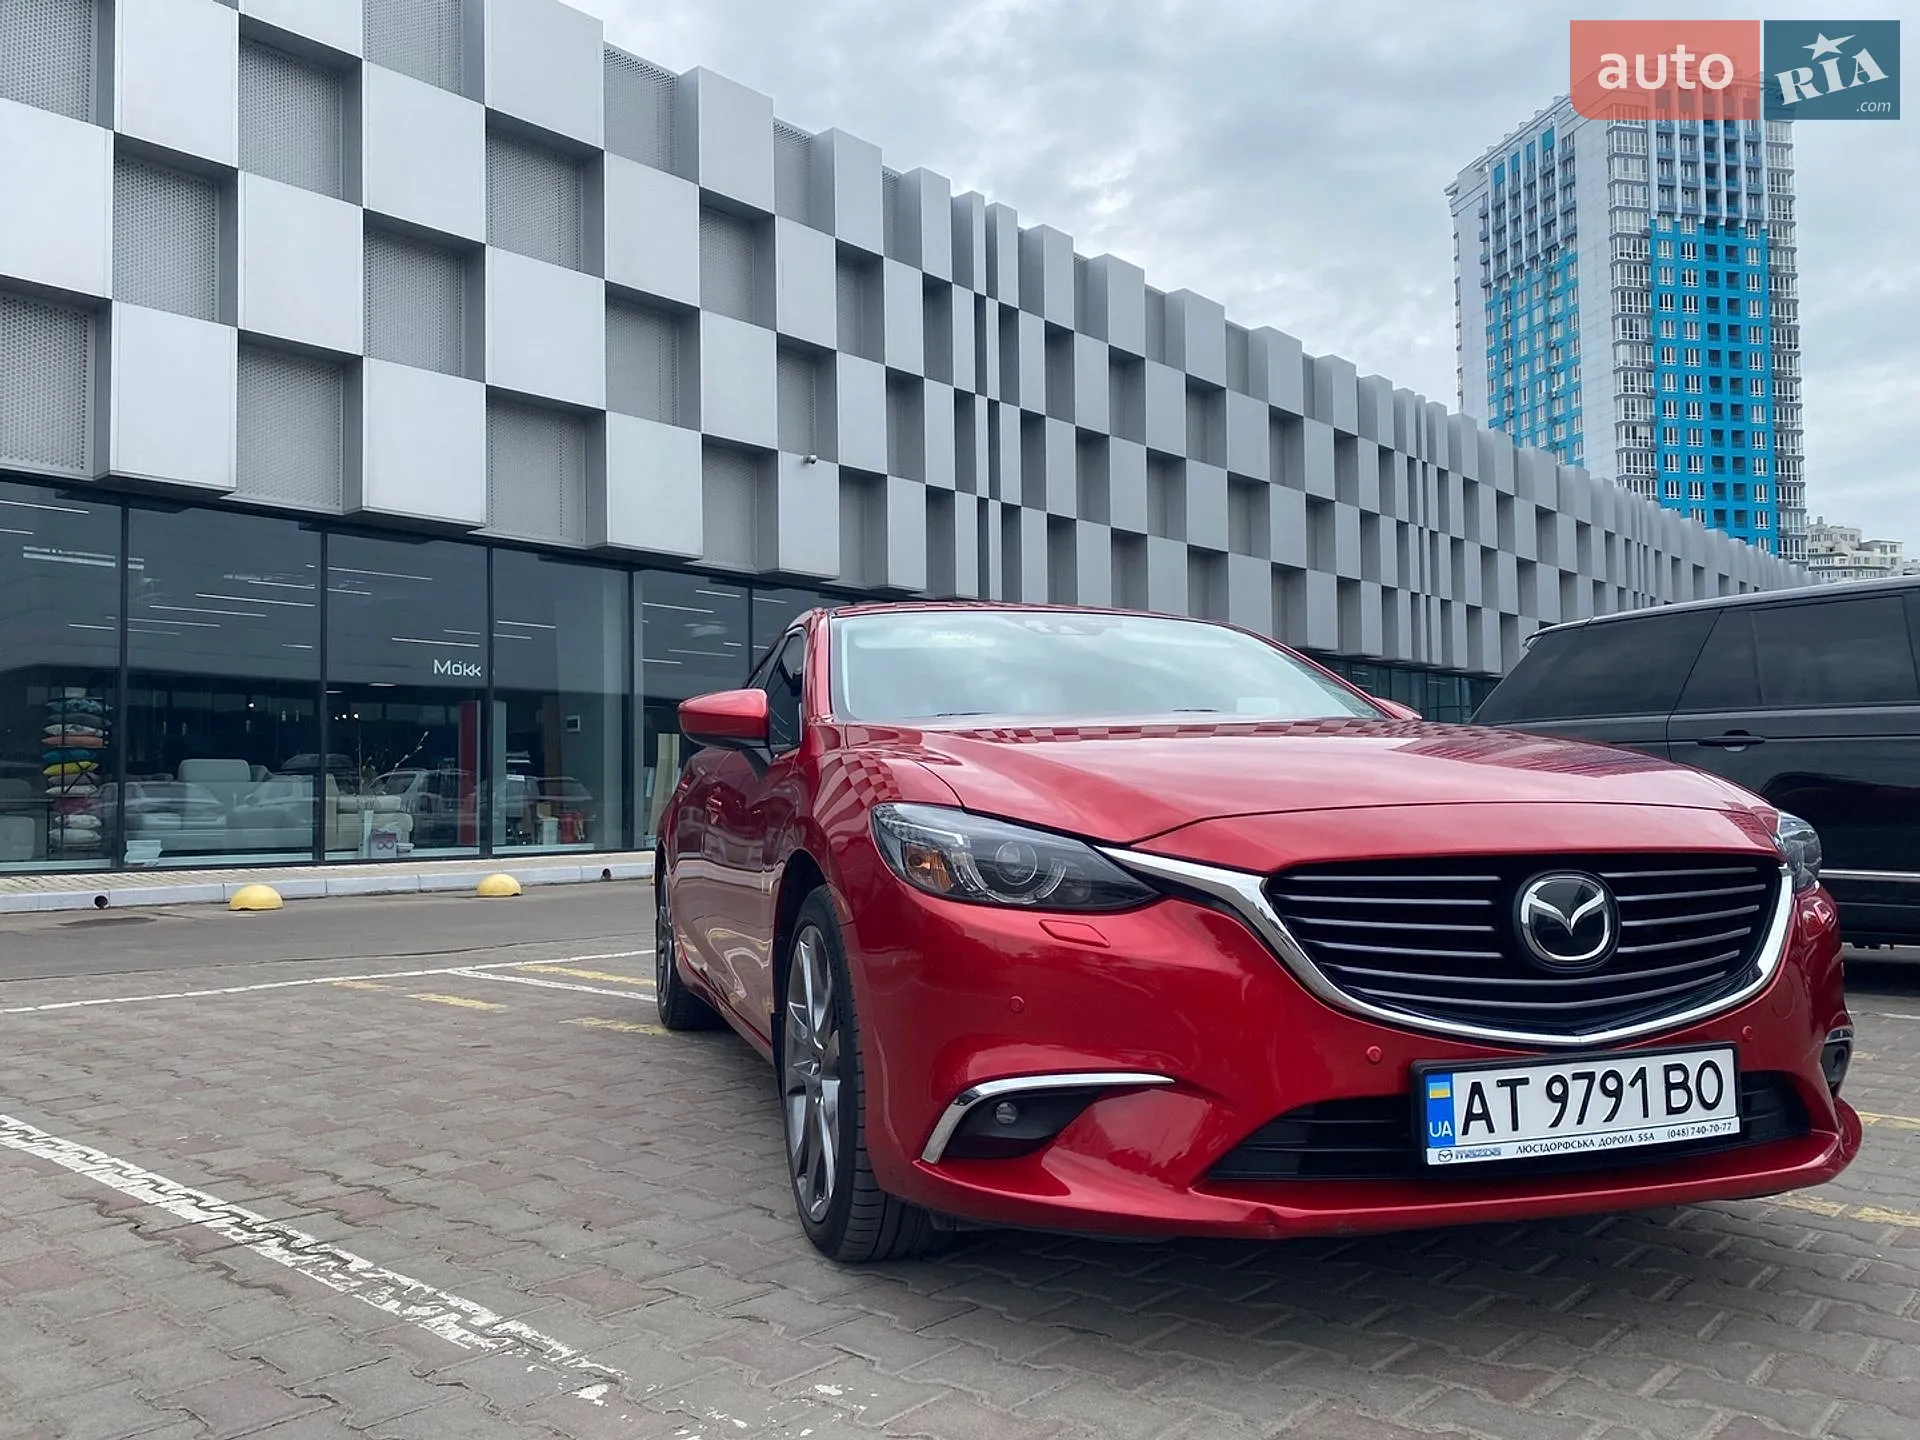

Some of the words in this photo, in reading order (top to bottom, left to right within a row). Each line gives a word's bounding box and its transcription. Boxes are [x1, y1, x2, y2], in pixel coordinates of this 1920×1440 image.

[1461, 1077, 1530, 1136] AT
[1545, 1066, 1650, 1128] 9791
[1664, 1059, 1723, 1116] BO
[1429, 1120, 1453, 1137] UA
